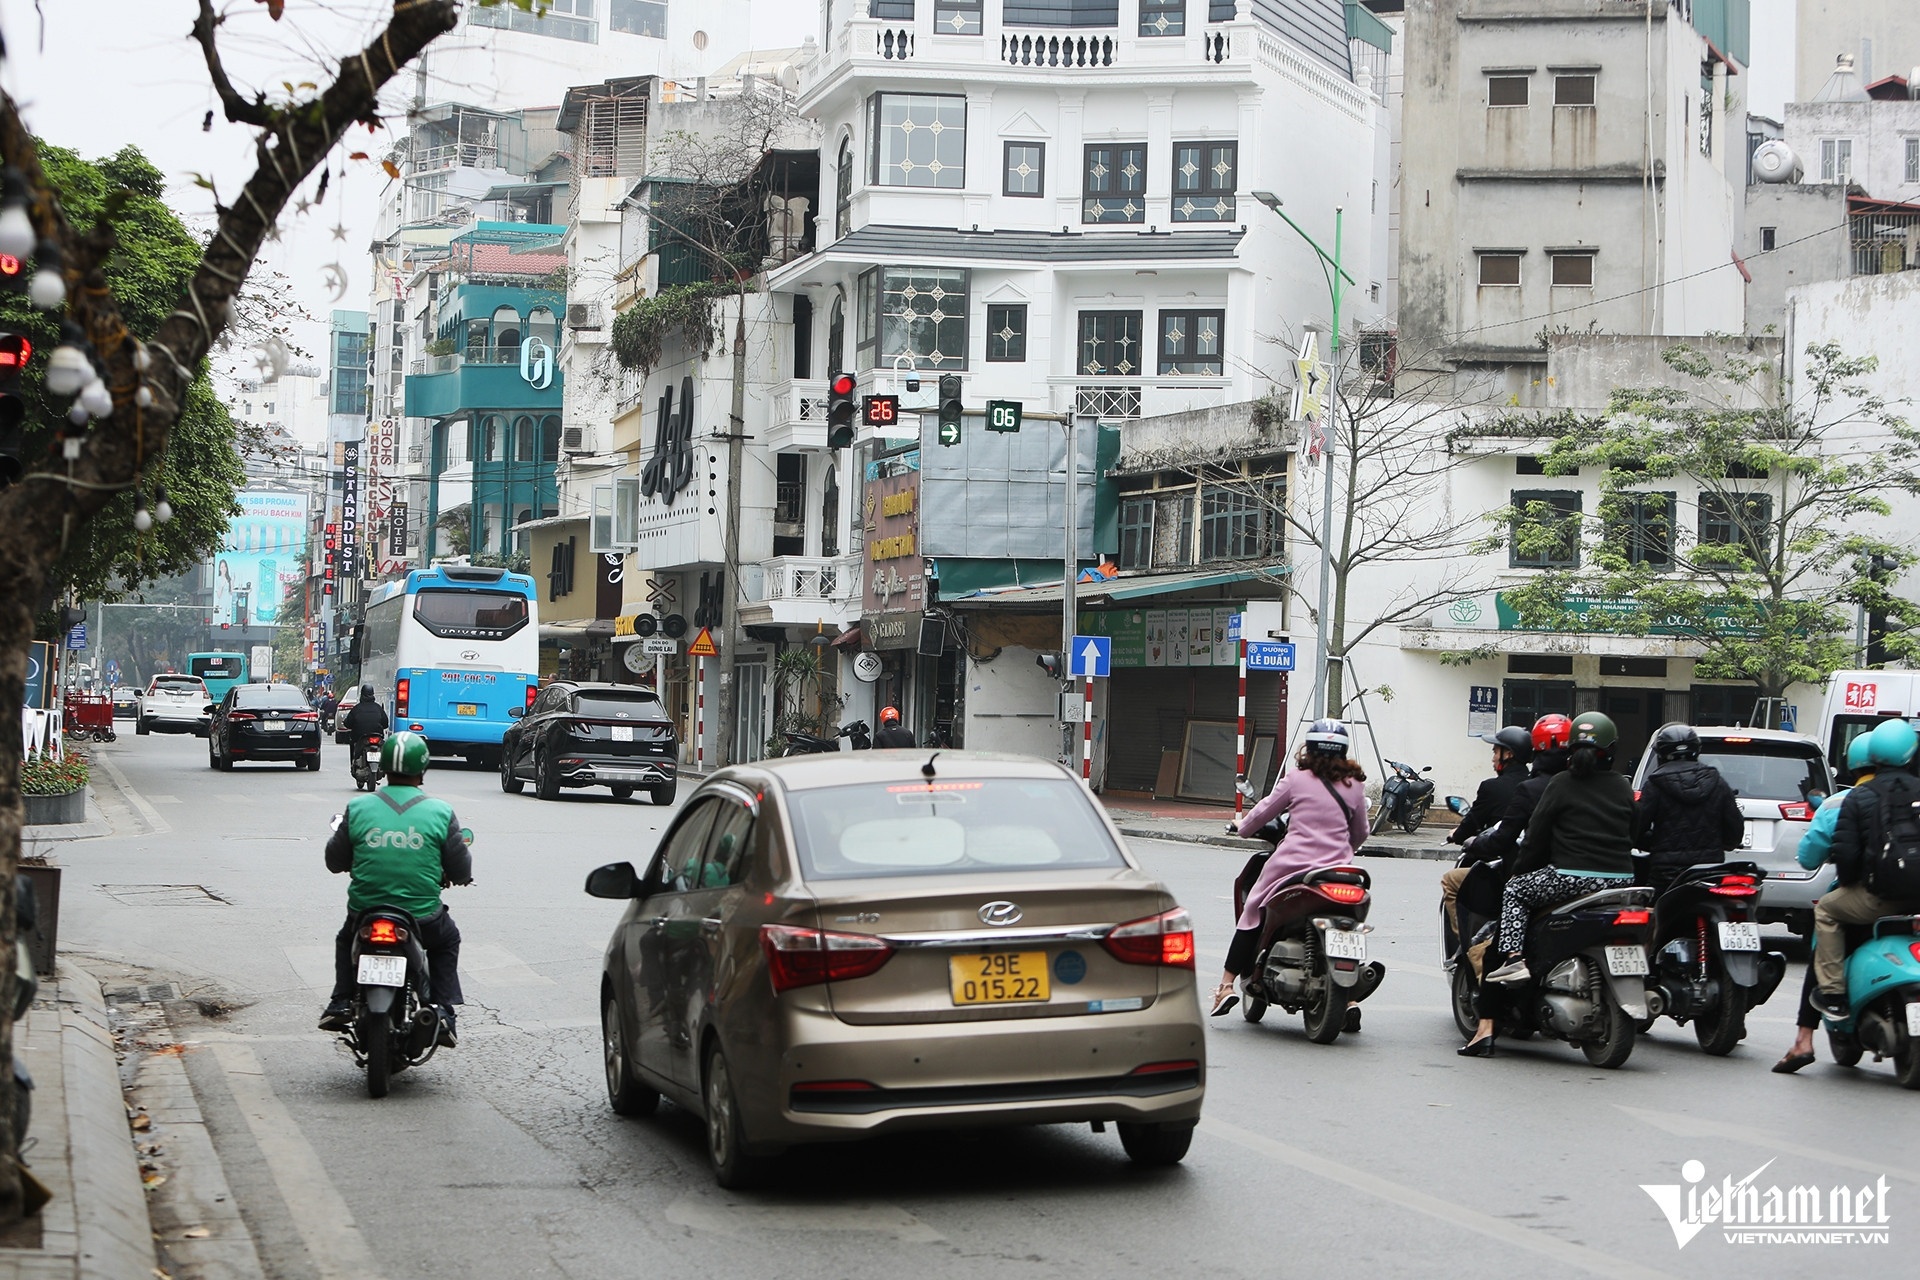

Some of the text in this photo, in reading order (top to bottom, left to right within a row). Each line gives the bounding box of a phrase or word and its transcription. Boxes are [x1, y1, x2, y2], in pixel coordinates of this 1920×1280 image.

[870, 401, 892, 420] 26
[993, 407, 1015, 427] 06
[380, 419, 394, 466] SHOES
[342, 465, 357, 572] STARDUST
[393, 507, 405, 555] HOTEL
[325, 523, 336, 595] HOTEL
[440, 628, 503, 637] UNIVERSE
[880, 621, 907, 638] GLOSSY
[1250, 652, 1290, 666] LÊ DUẨN
[365, 826, 425, 850] Grab
[1332, 931, 1361, 946] 29-N1
[1723, 937, 1759, 950] 060.45
[1329, 943, 1364, 959] 719.11
[1612, 947, 1640, 960] 29-P1
[979, 954, 1021, 976] 29E
[1611, 960, 1646, 973] 956.79
[963, 977, 1040, 1001] 015.22
